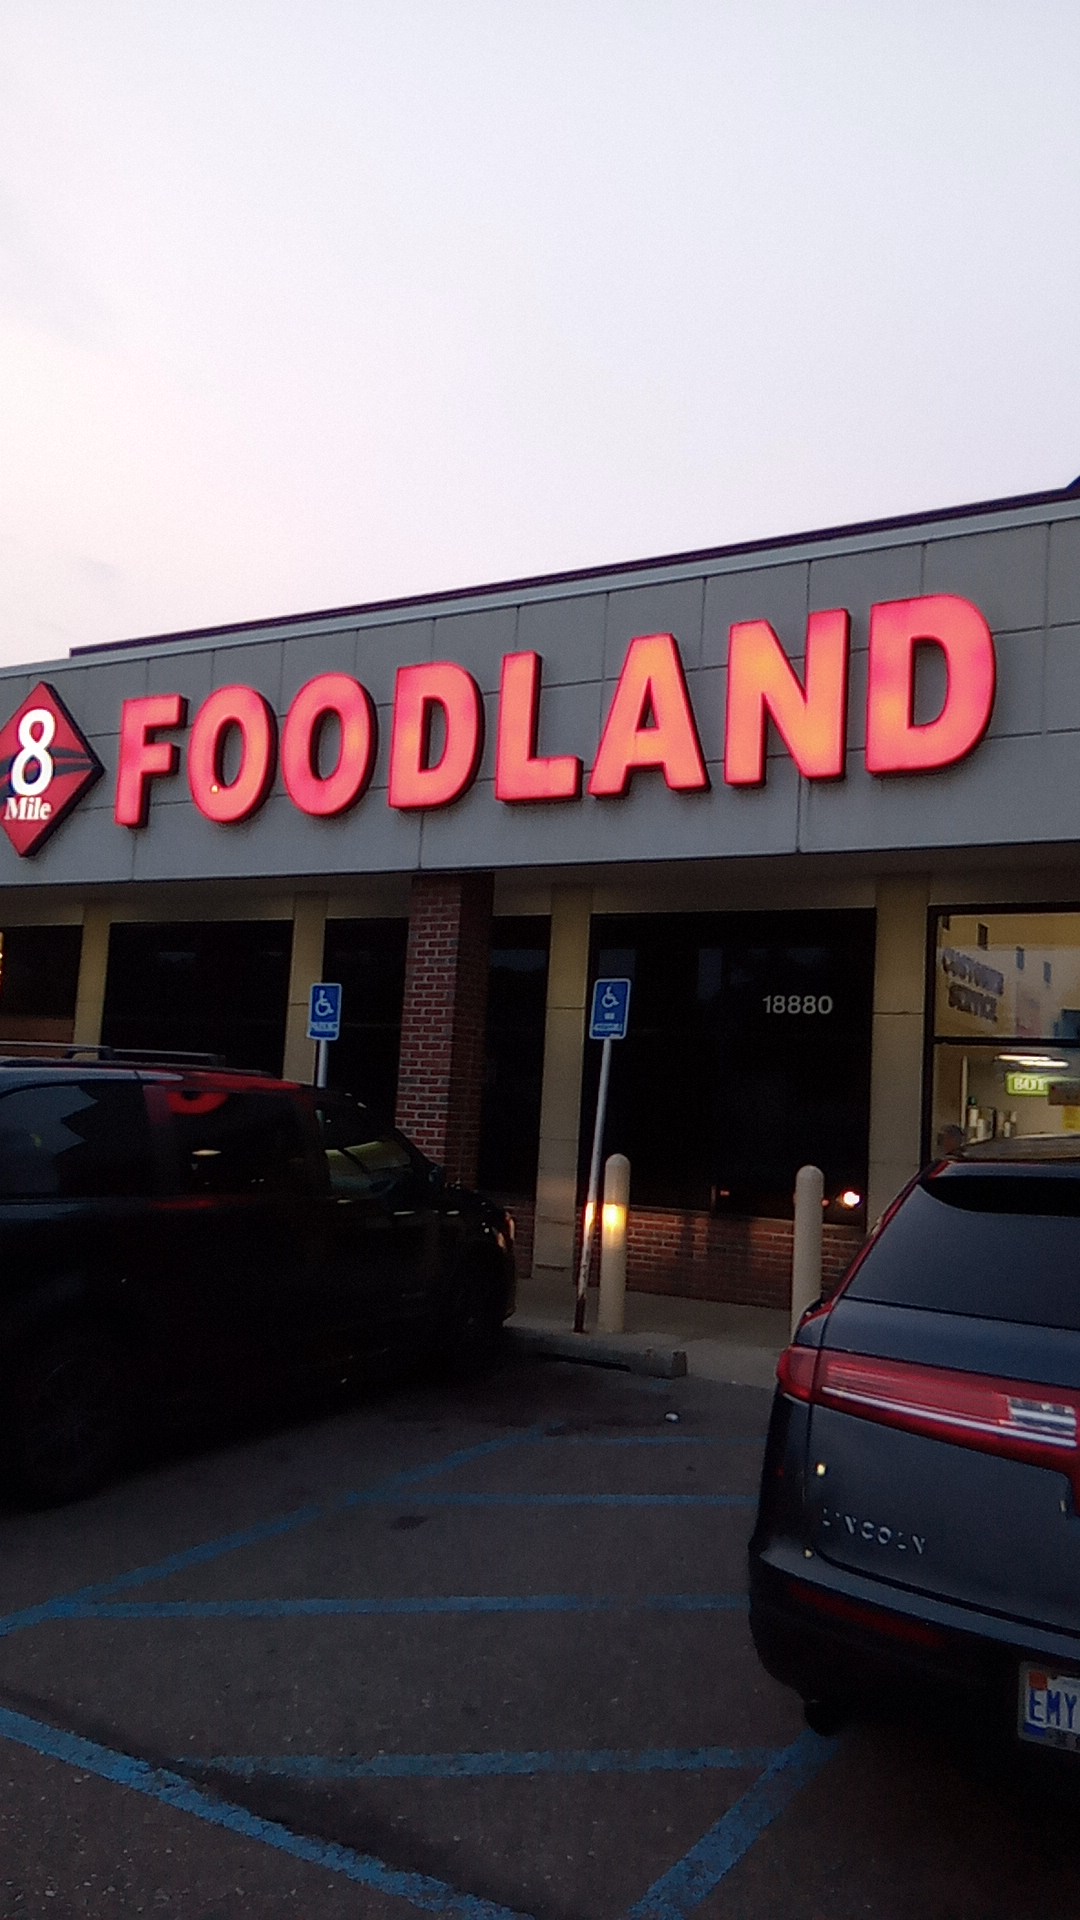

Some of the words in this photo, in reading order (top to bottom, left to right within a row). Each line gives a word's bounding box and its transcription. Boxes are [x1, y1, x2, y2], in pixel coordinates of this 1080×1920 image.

[115, 594, 996, 826] FOODLAND
[11, 708, 56, 797] 8
[4, 797, 52, 820] Mile
[763, 995, 833, 1014] 18880
